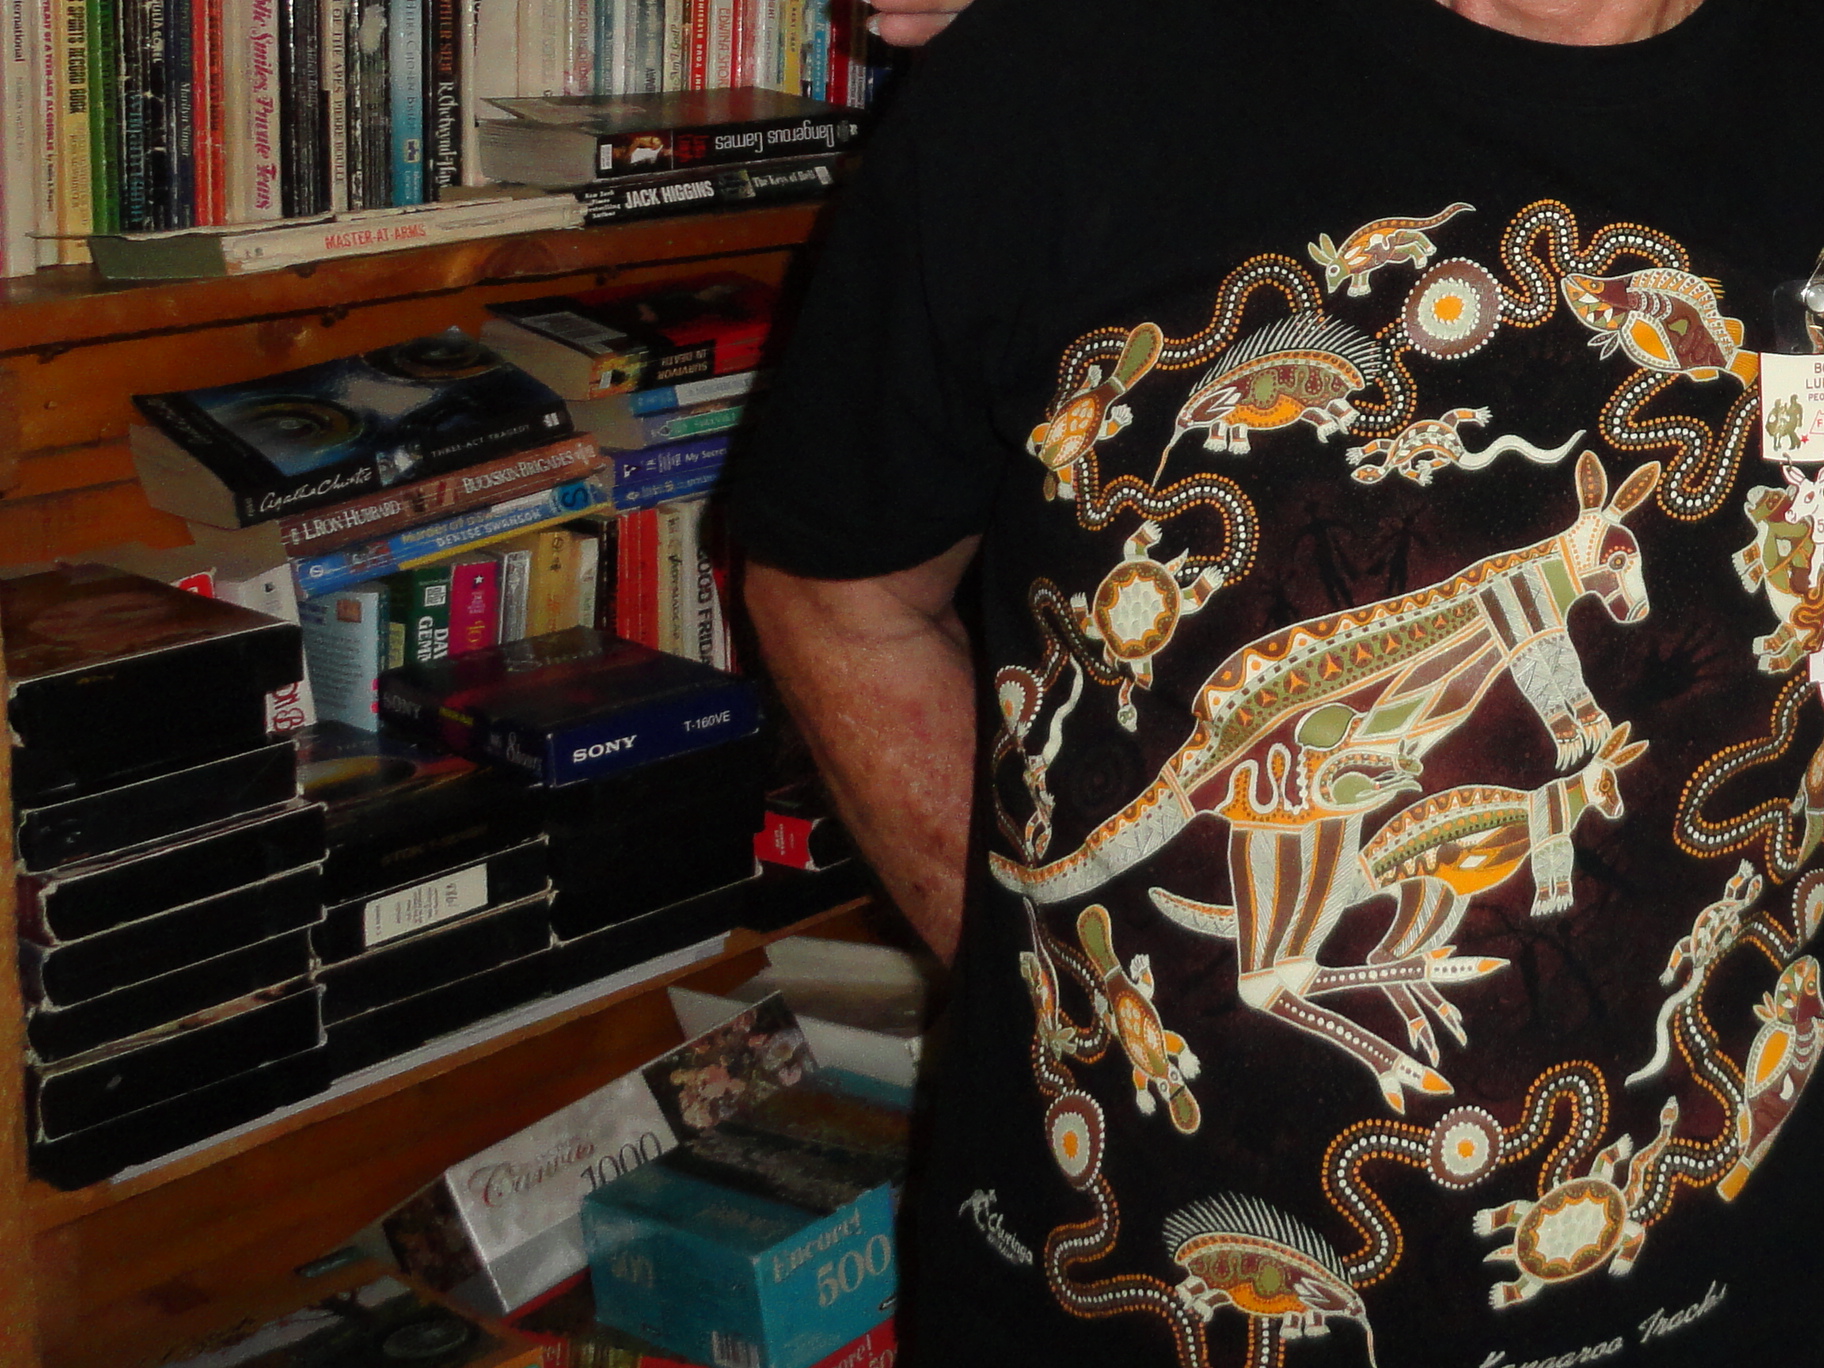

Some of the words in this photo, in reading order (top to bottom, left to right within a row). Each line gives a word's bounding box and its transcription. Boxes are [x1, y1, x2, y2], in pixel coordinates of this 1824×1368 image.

[67, 6, 84, 44] SPORTS
[332, 8, 342, 24] OF
[718, 8, 729, 50] EDWINA
[332, 32, 343, 57] THE
[68, 47, 85, 85] RECORD
[332, 61, 343, 94] APES
[69, 89, 86, 114] BOOK
[333, 100, 344, 137] PIERRE
[254, 96, 275, 159] Private
[715, 130, 764, 153] Games
[767, 119, 834, 148] Dangerous
[255, 162, 276, 210] Tears
[625, 188, 659, 209] JACK
[661, 179, 715, 204] HIGGINS
[324, 222, 426, 251] MASTER-AT-ARMS
[260, 480, 316, 514] Agatha
[314, 464, 375, 502] Christie
[462, 461, 518, 497] BUCKSKIN
[516, 446, 576, 481] BRIGADES
[342, 498, 402, 536] HUBBARD
[486, 506, 544, 534] SWANSON
[572, 734, 639, 764] SONY
[684, 709, 732, 733] T-160VE
[816, 1230, 892, 1309] 500
[1638, 1280, 1728, 1345] Tracks
